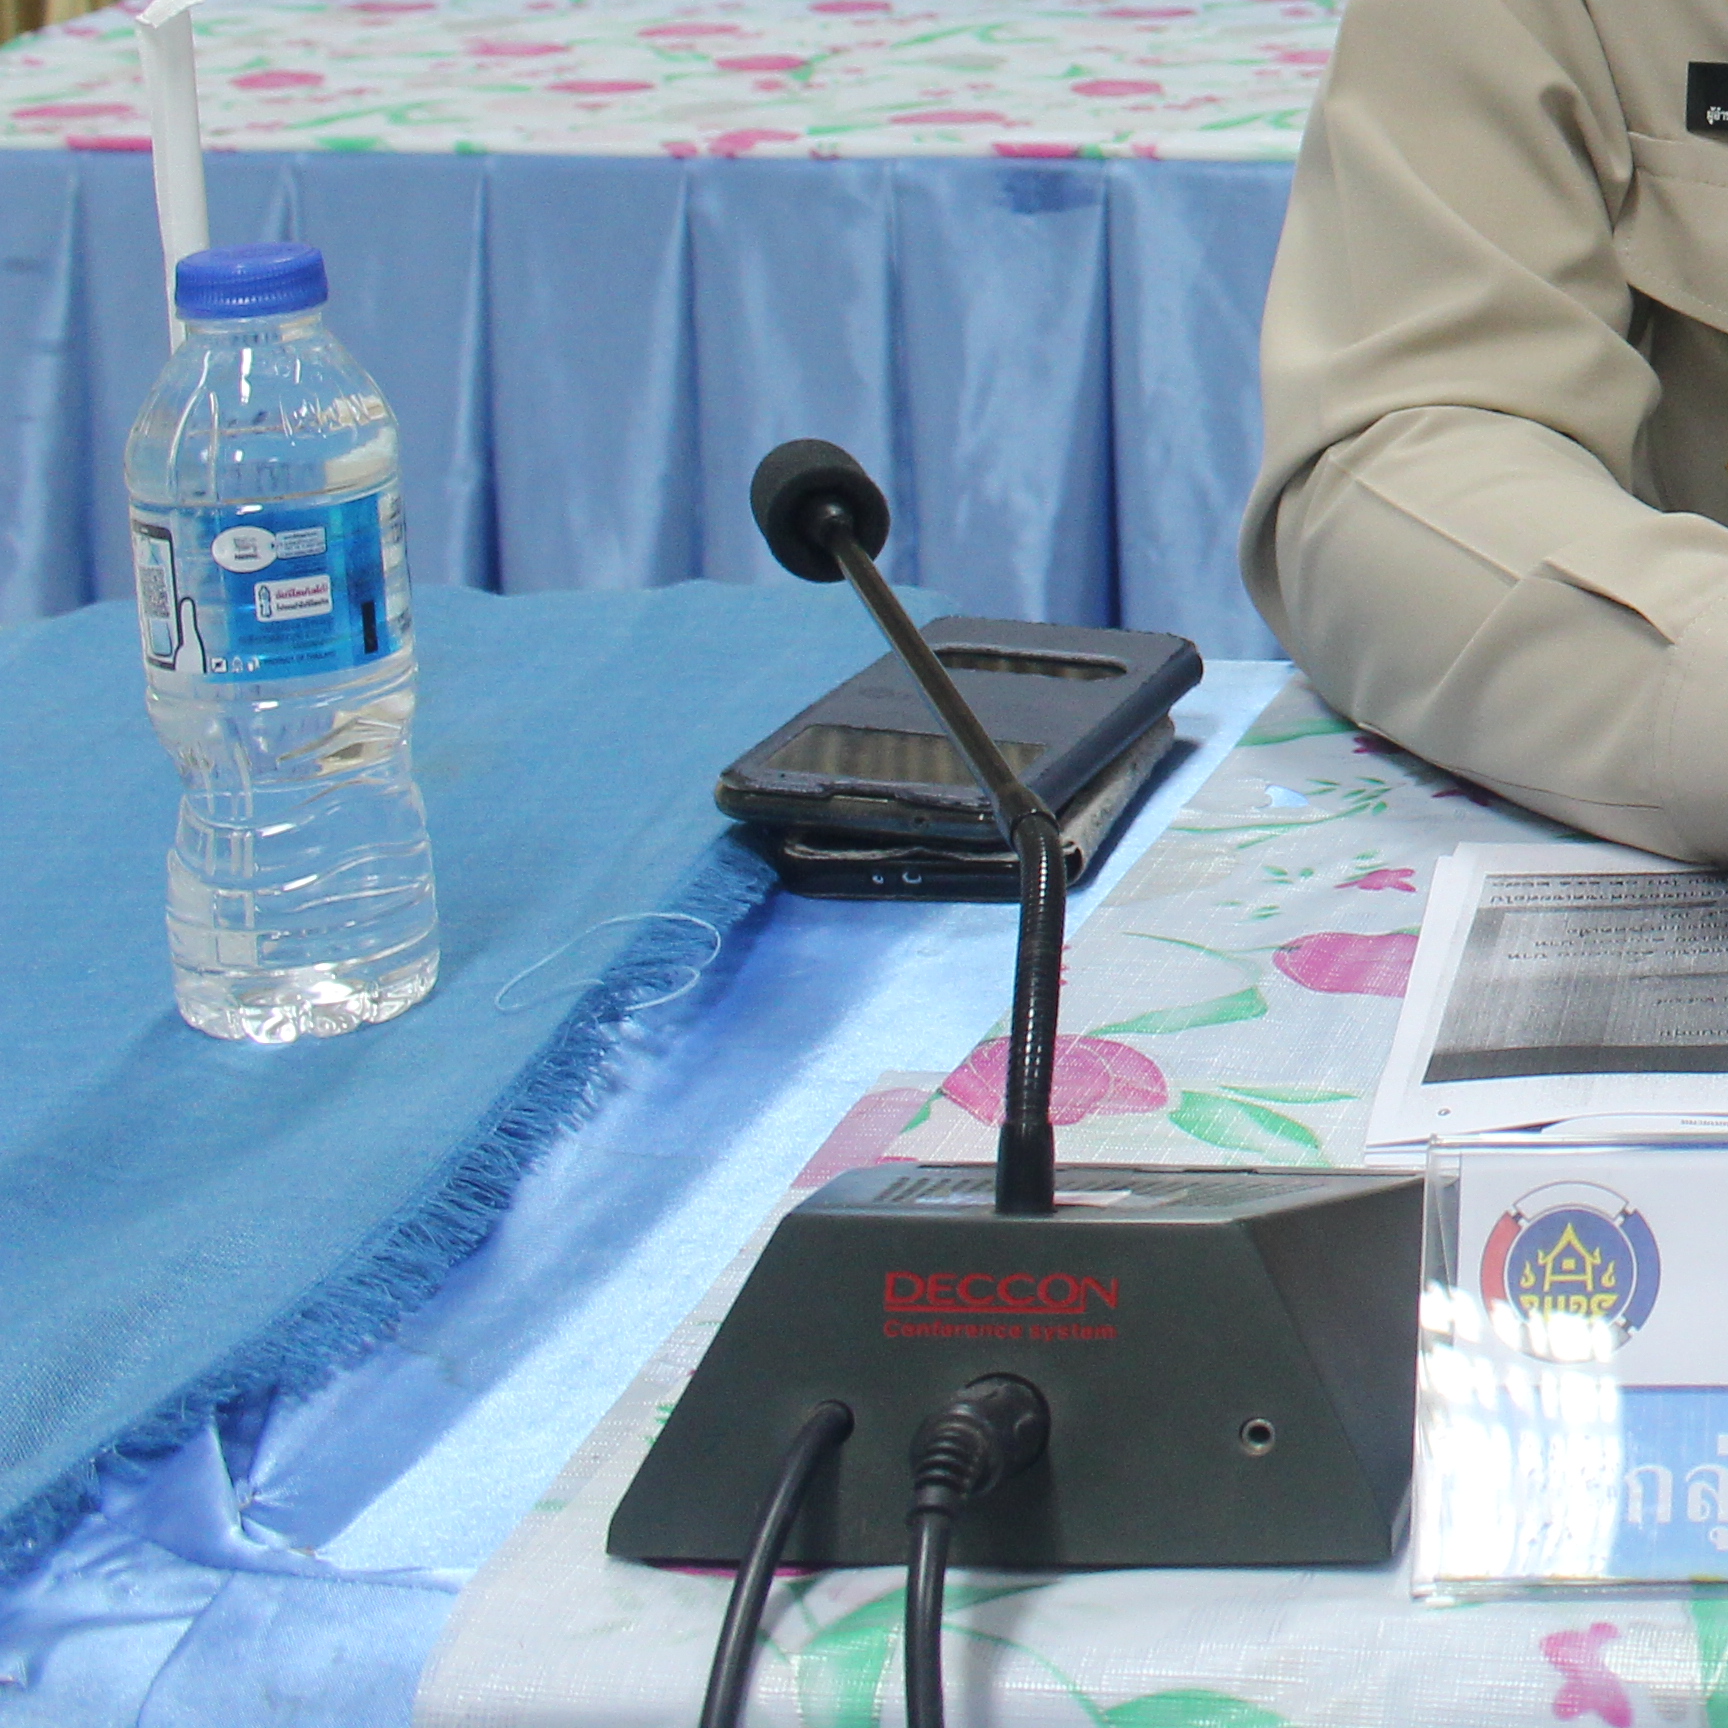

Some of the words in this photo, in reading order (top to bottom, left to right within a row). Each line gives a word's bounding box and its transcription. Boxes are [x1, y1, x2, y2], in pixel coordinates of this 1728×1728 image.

[883, 1270, 1120, 1312] DECCON
[883, 1318, 1023, 1339] Conference
[1029, 1320, 1119, 1343] system
